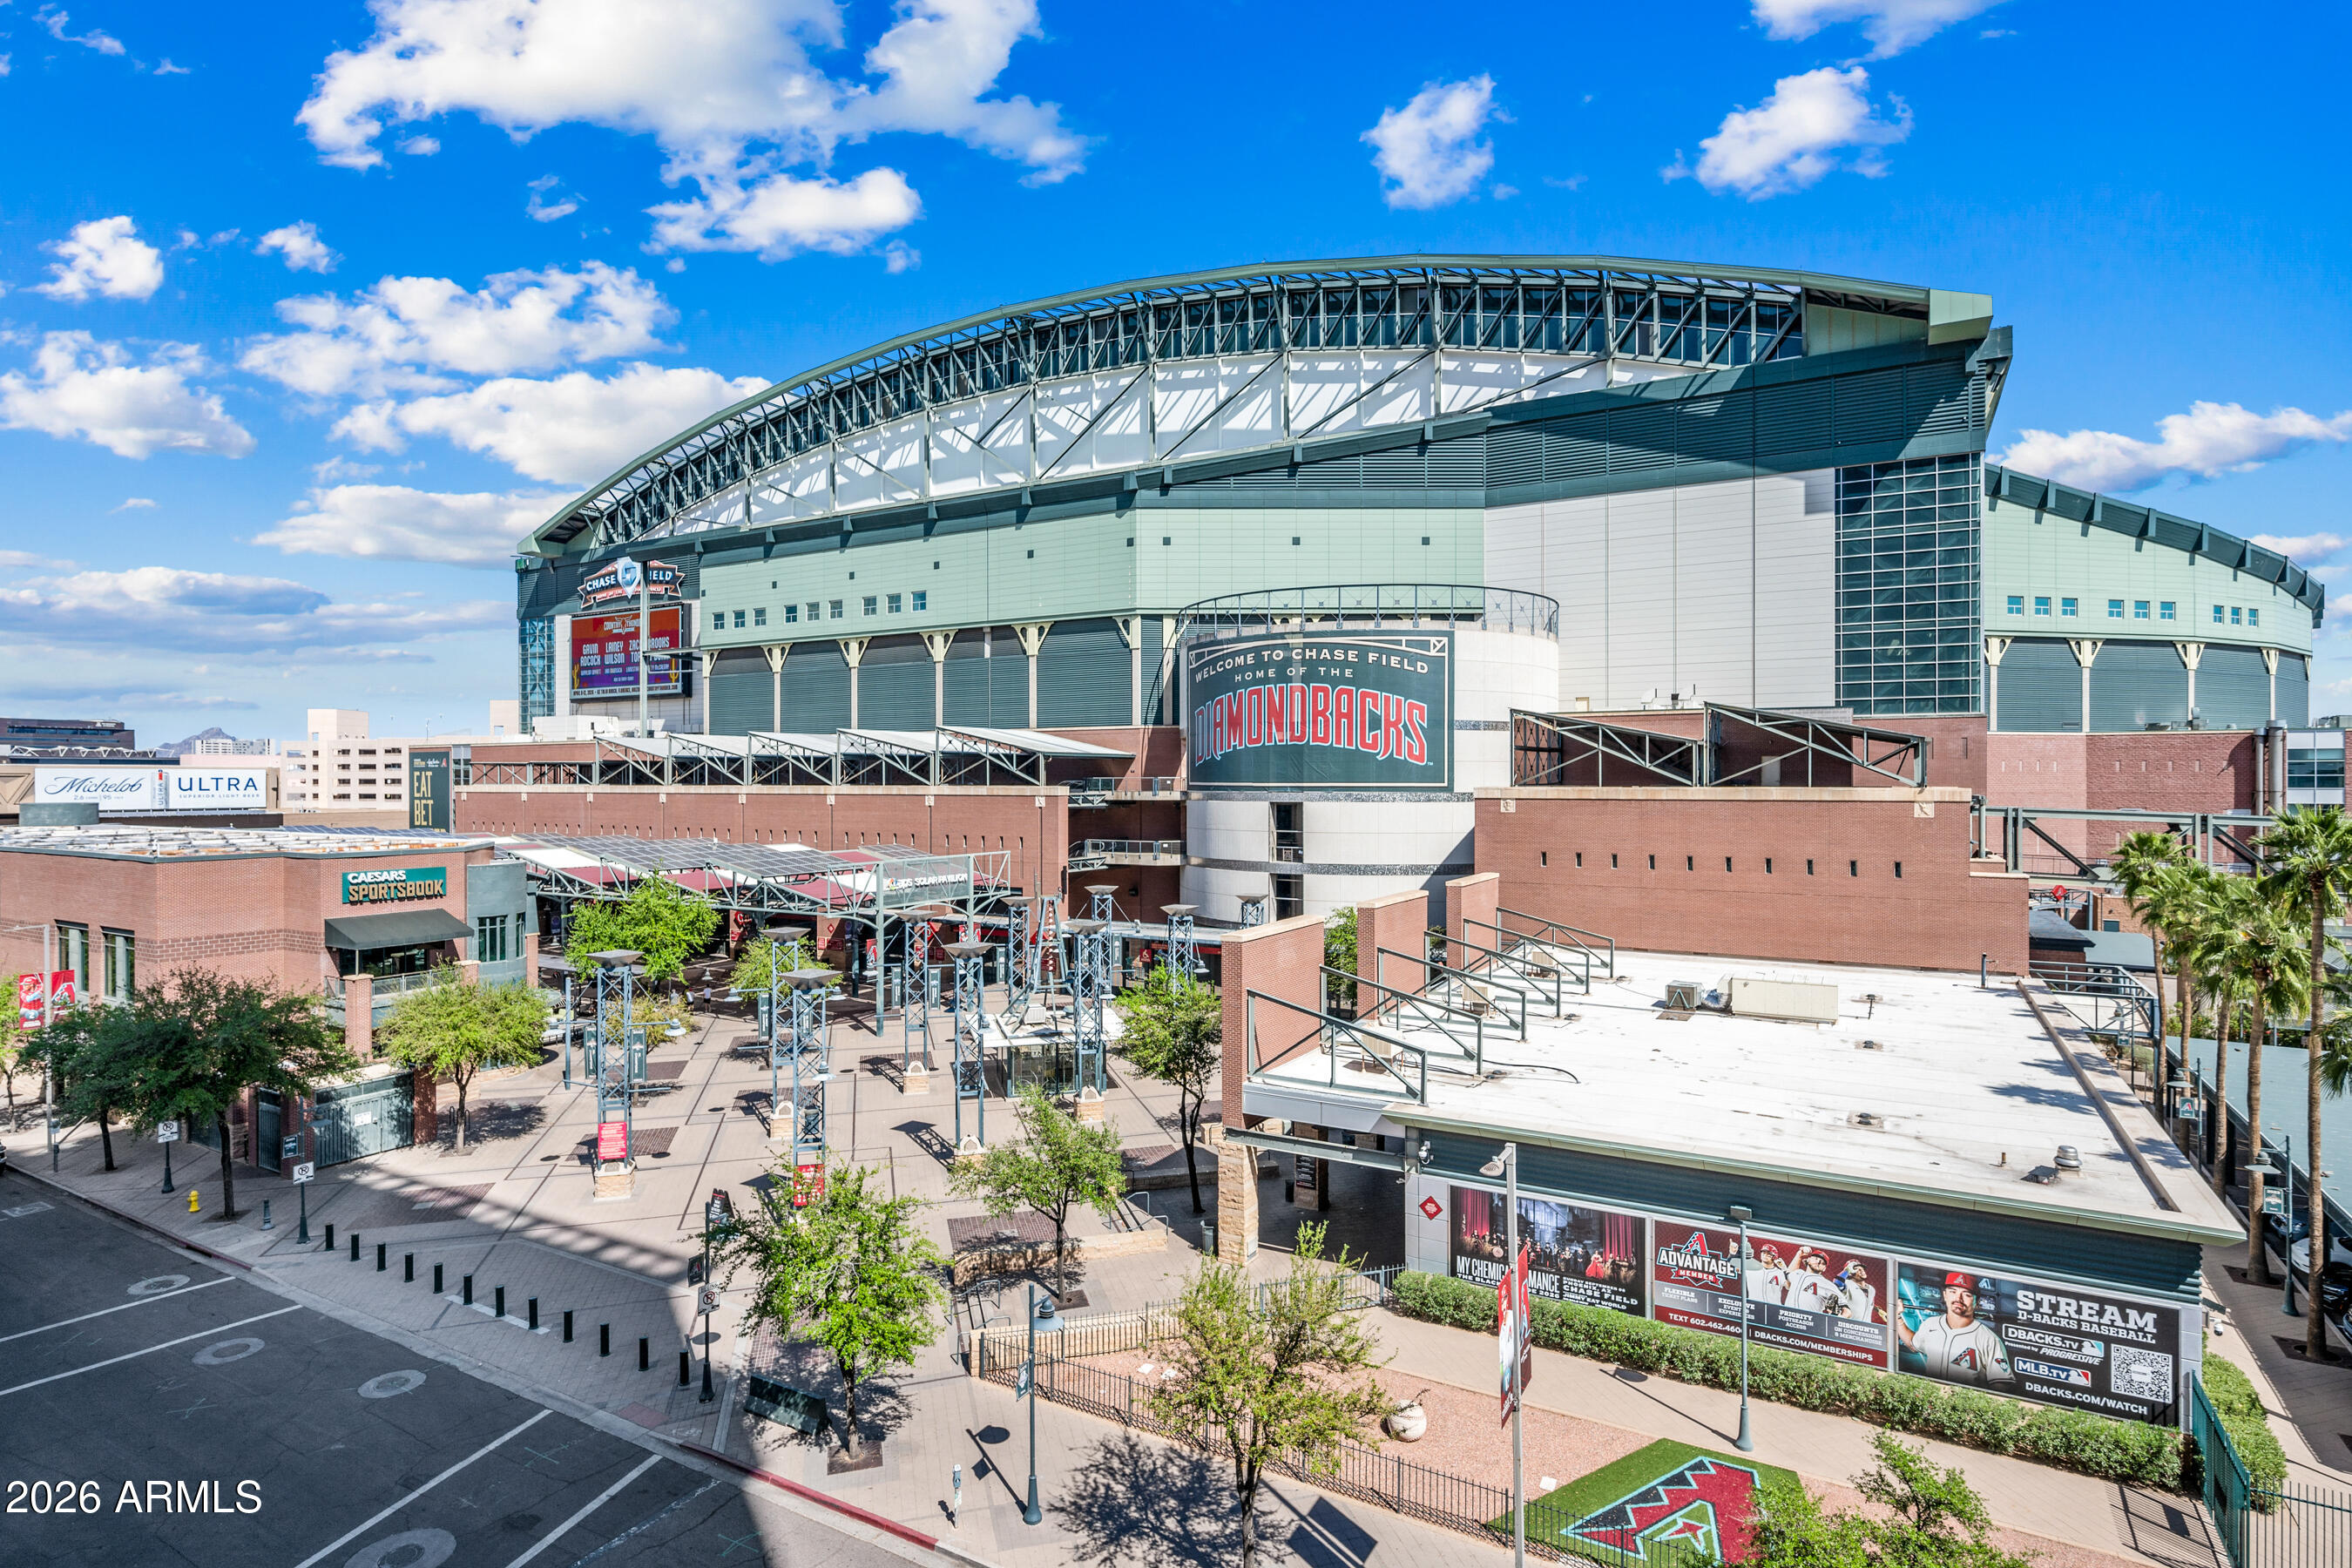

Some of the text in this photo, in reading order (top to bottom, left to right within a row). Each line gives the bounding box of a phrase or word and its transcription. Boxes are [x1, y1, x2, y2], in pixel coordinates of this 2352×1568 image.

[585, 571, 673, 591] CHASE IELD
[583, 644, 598, 655] GAVIN
[605, 641, 624, 653] LAINEY
[629, 639, 641, 651] ZAC
[580, 655, 601, 666] ADCOCK
[604, 652, 625, 665] WILSON
[1195, 648, 1429, 684] WELCOME TO CHASE FIELD
[1234, 666, 1355, 683] HOME OF THE
[1194, 682, 1428, 767] DIAMONDBACKS
[44, 776, 146, 794] Michelob
[178, 777, 258, 792] ULTRA
[414, 771, 432, 797] EAT
[414, 799, 434, 826] BET
[348, 870, 406, 883] CAESARS
[914, 875, 937, 887] SOLAR
[937, 873, 968, 884] PAVILION
[348, 879, 443, 902] SPORTSBOOK
[1659, 1249, 1735, 1276] ADVANTAGE
[1456, 1255, 1560, 1294] MY CHEMICA MANCE
[1680, 1269, 1714, 1281] MEMBER
[1563, 1281, 1599, 1291] PHOENIX,
[1585, 1281, 1618, 1291] SEPTEMBER
[1665, 1287, 1695, 1298] FLEXIBLE
[1563, 1285, 1600, 1297] CHASE
[1604, 1294, 1638, 1305] FIELD
[1661, 1292, 1698, 1304] TICKET PLANS
[1601, 1301, 1626, 1309] WORLD
[2017, 1289, 2158, 1334] STREAM
[1719, 1308, 1755, 1320] EXPERIECES
[1778, 1315, 1814, 1327] POSTSEASON
[1779, 1309, 1813, 1321] PRIORITY
[1785, 1321, 1807, 1330] ACCESS
[1838, 1321, 1879, 1334] DISCOUNTS
[2017, 1309, 2156, 1344] D-BACKS BASEBALL
[1668, 1313, 1874, 1362] TEXT 602.462.460 DBACKS.COM/MEMBERSHIPS
[1840, 1332, 1882, 1345] MERCHANDISE
[1843, 1328, 1882, 1341] CONCESSIONS
[2008, 1327, 2078, 1349] DBACKS.TV
[2004, 1341, 2031, 1350] Presented
[2039, 1347, 2103, 1365] PROGRESSIVE
[2018, 1360, 2068, 1379] MLB.TV
[2025, 1382, 2148, 1416] DBACKS.COM/WATCH
